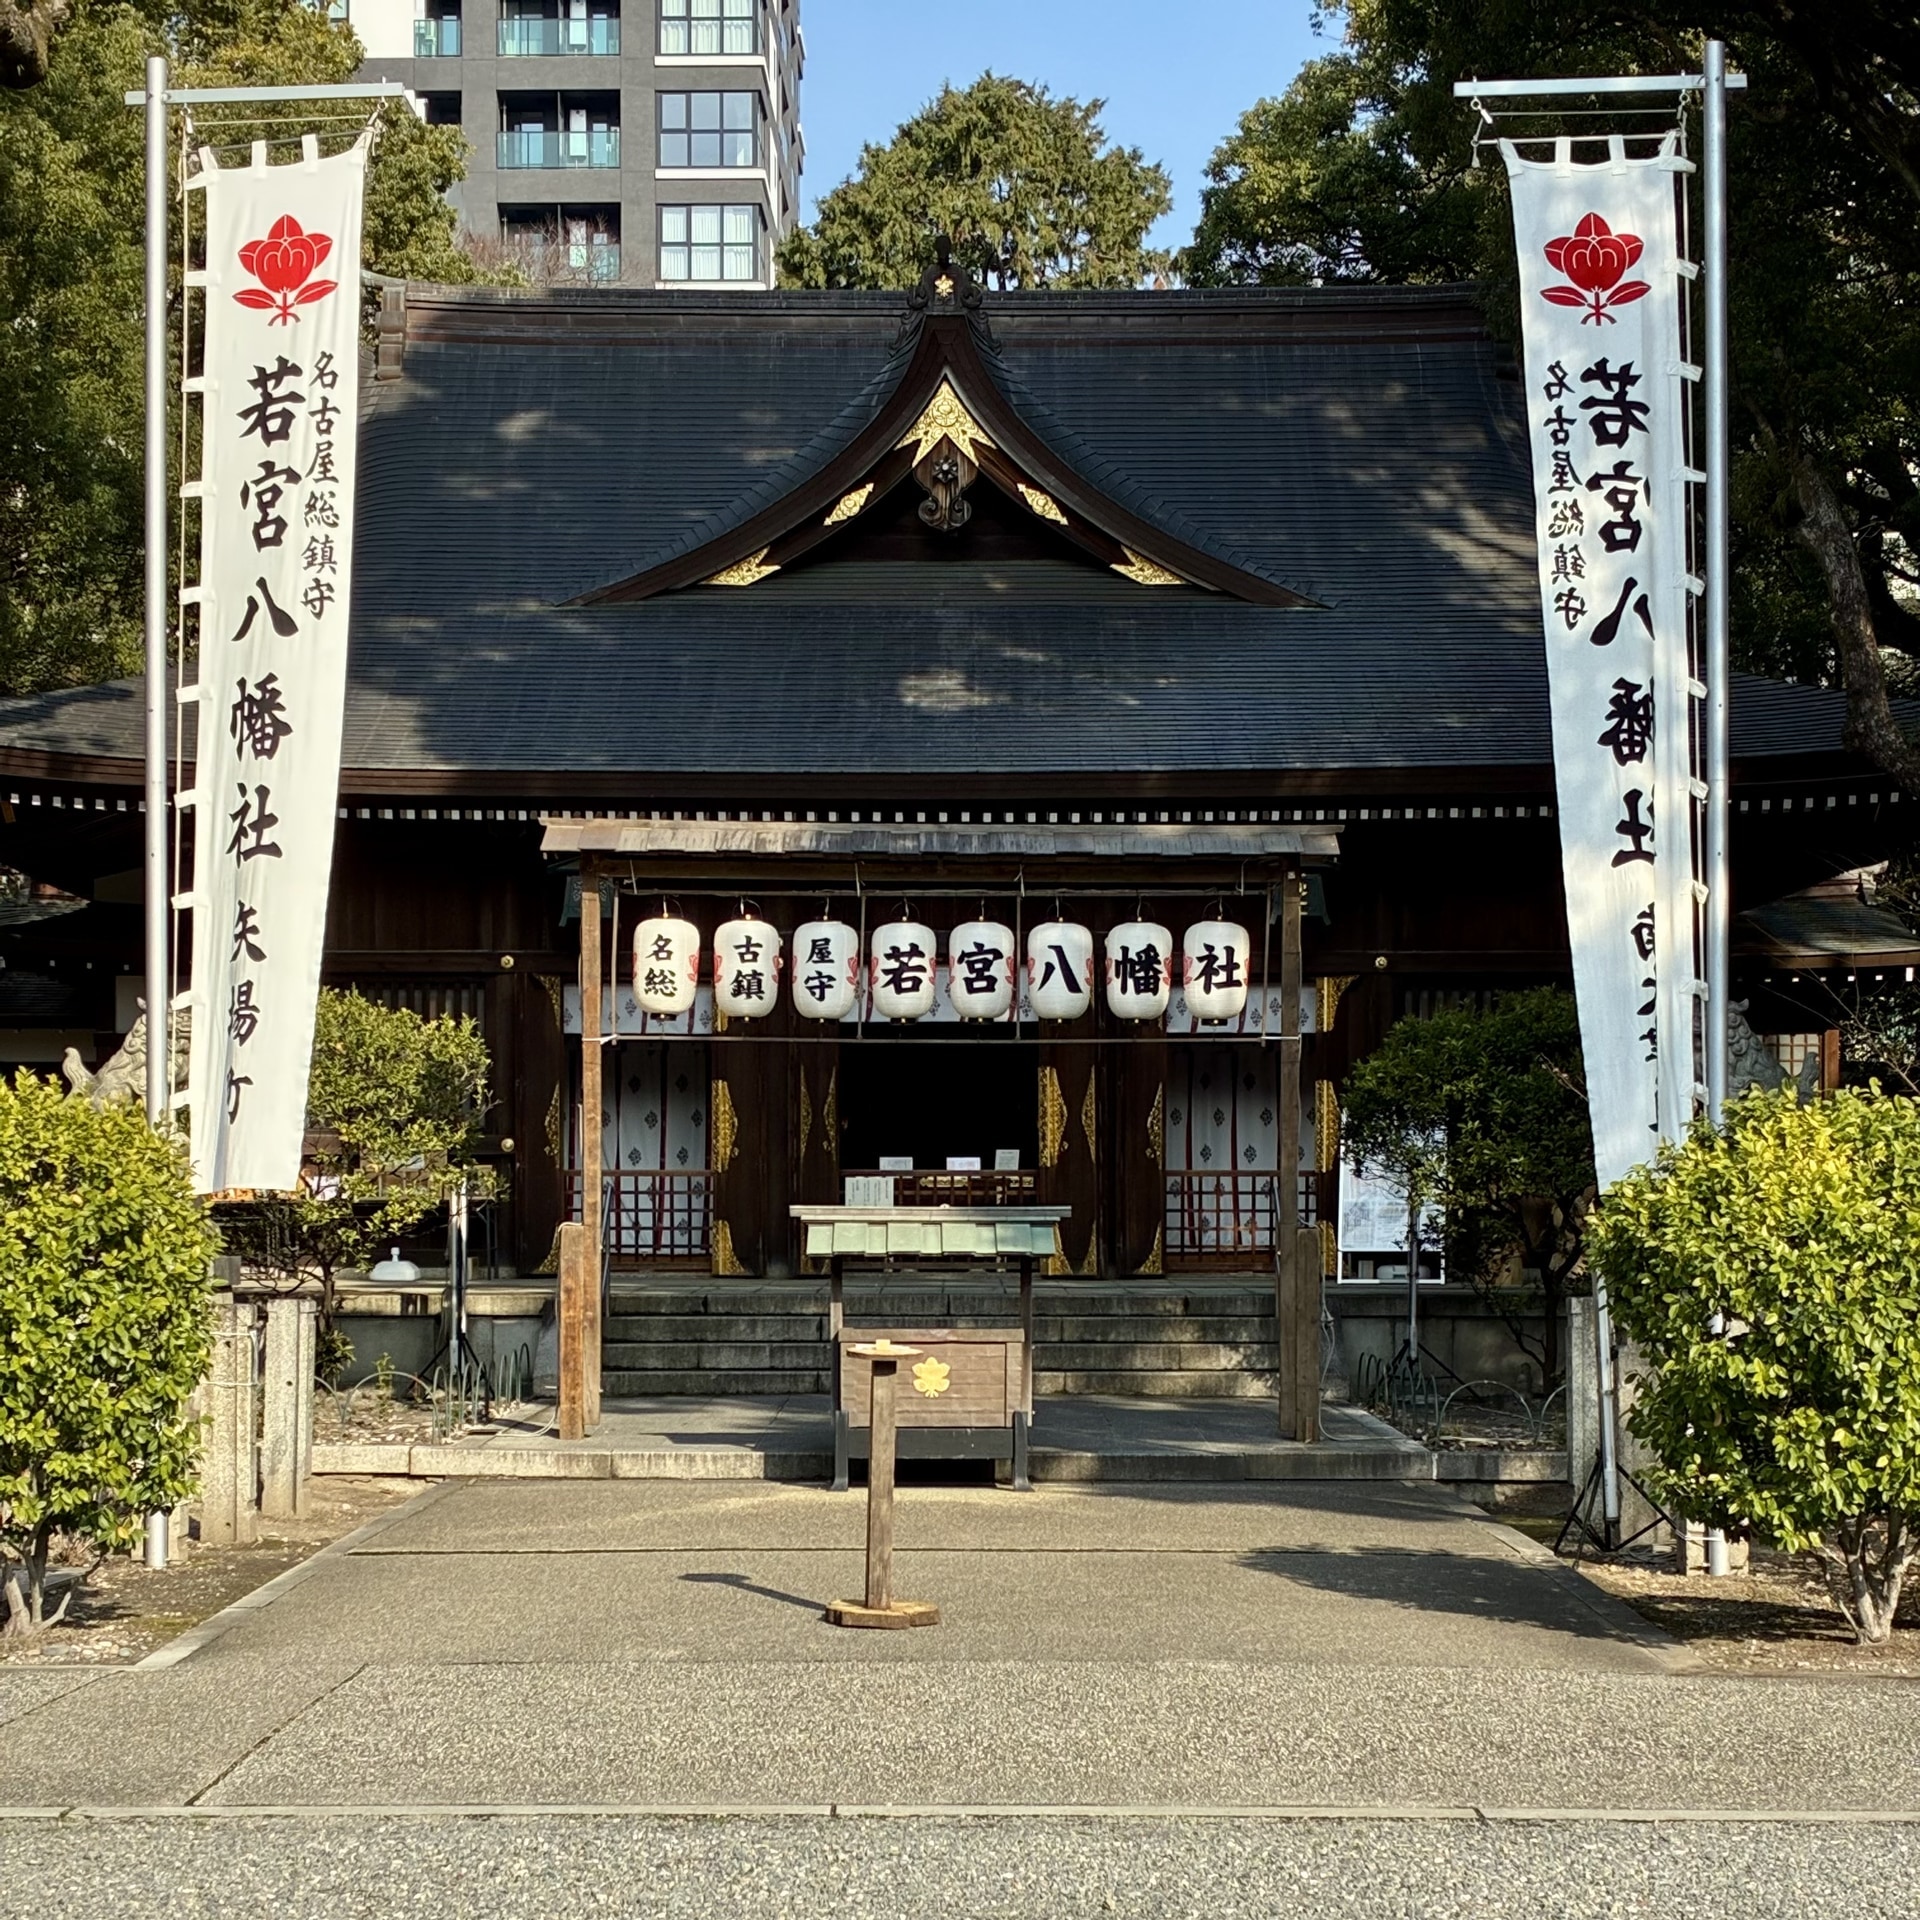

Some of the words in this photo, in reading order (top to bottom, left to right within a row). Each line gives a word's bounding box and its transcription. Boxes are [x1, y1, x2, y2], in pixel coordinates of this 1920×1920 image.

[227, 354, 307, 870] 若宮八幡社
[299, 350, 340, 621] 名古屋総鎮守
